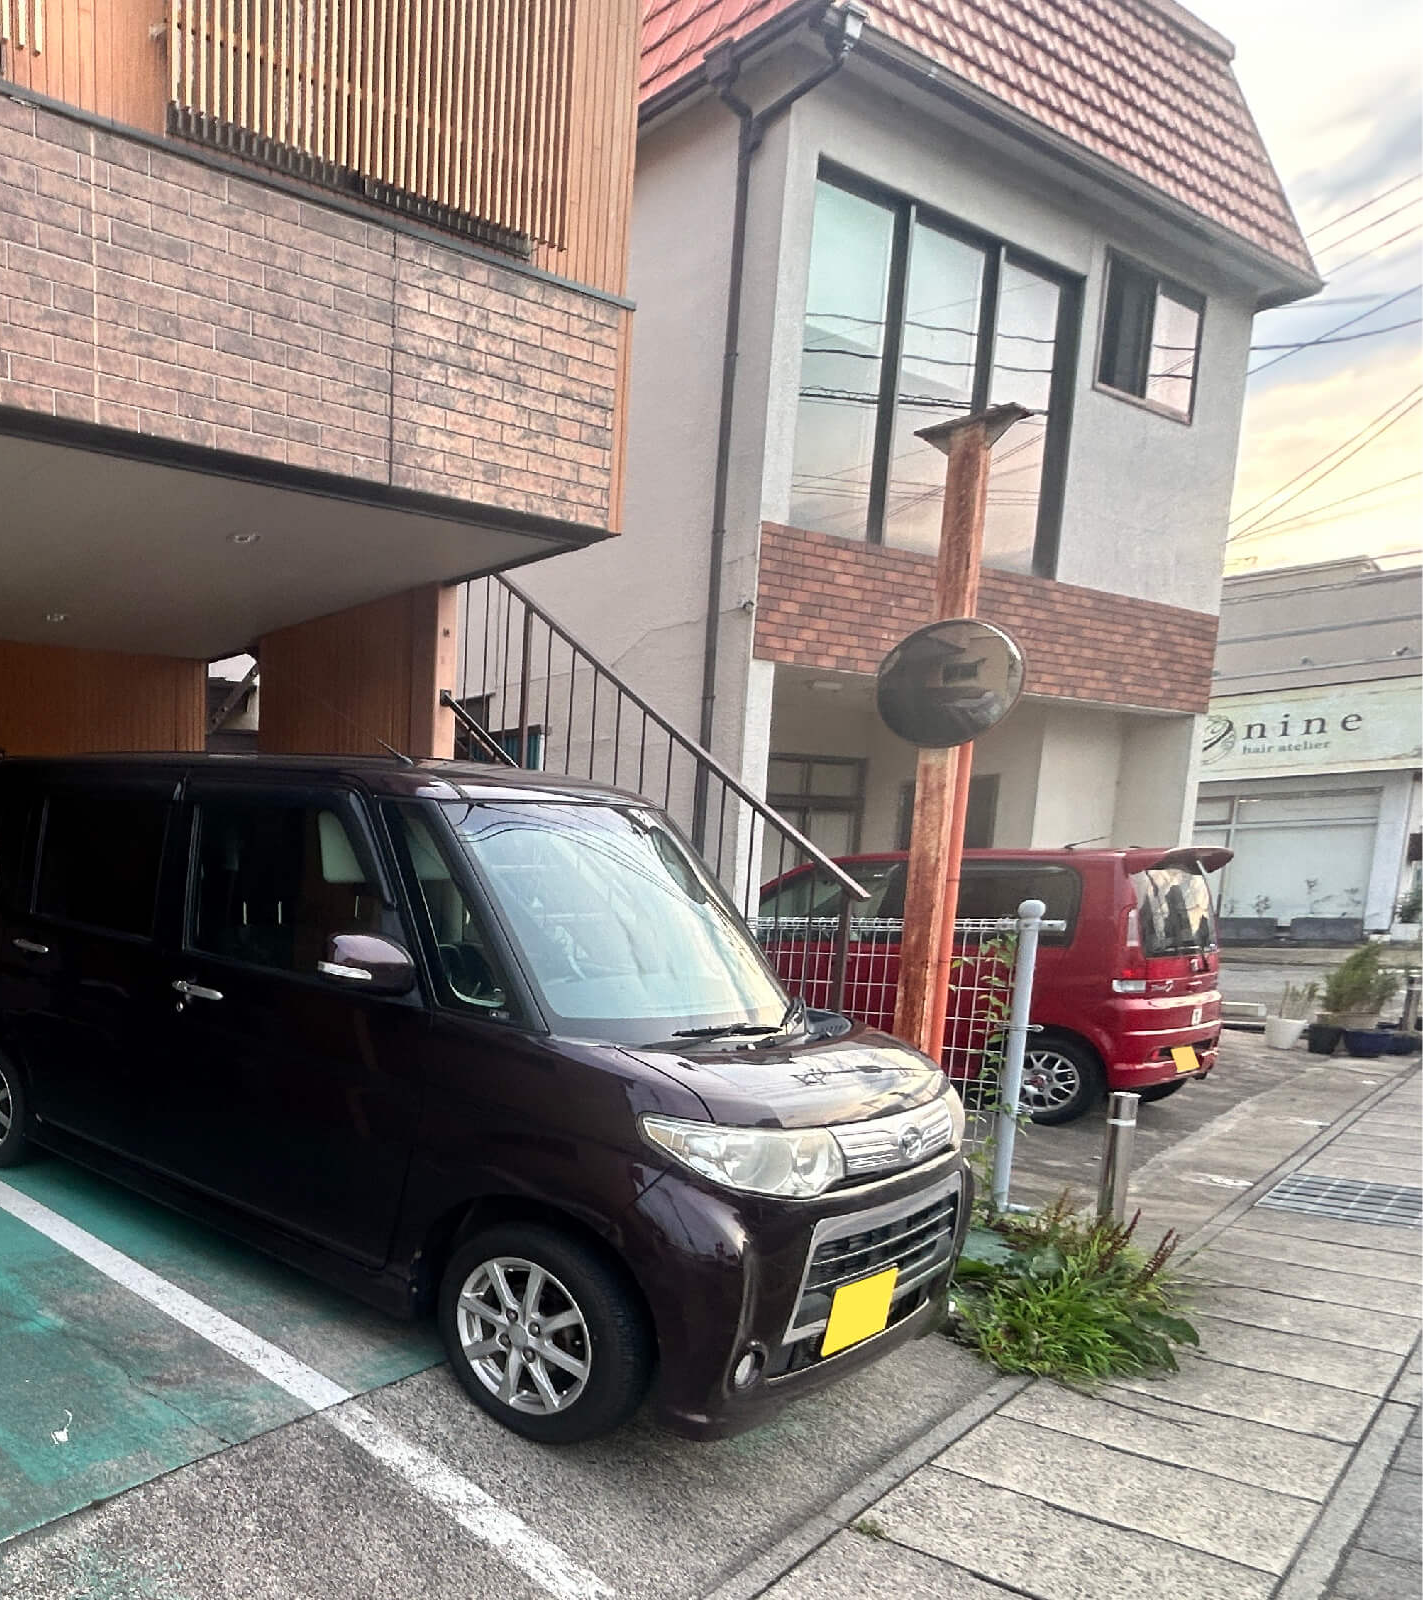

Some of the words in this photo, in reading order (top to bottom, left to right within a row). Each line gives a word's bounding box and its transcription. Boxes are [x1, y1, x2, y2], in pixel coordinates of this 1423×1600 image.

[1241, 713, 1363, 740] nine
[1242, 743, 1275, 755] hair
[1278, 740, 1331, 753] atelier
